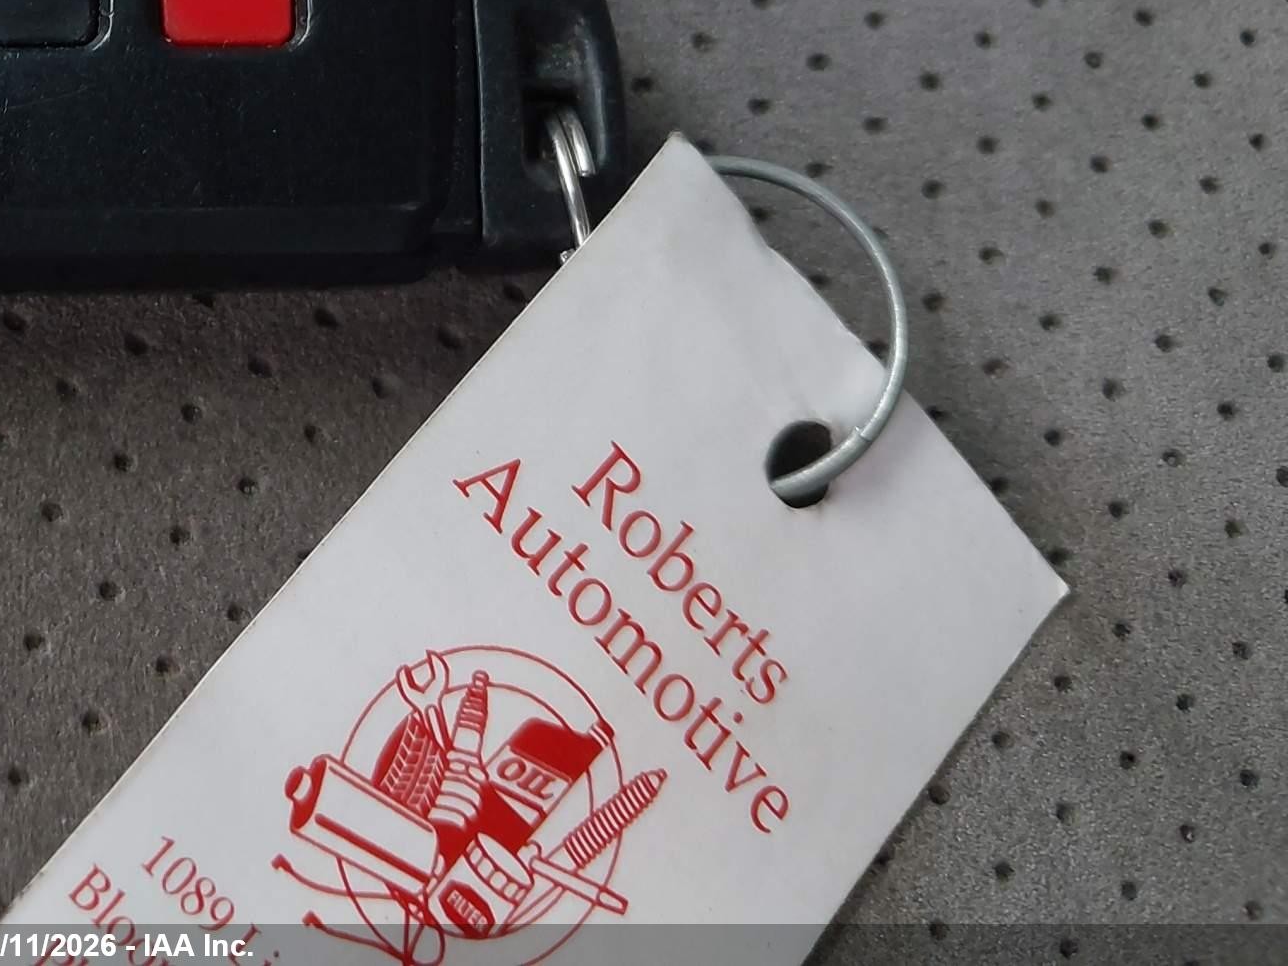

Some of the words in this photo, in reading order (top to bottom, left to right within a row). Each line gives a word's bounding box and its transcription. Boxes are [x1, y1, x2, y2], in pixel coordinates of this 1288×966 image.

[452, 458, 790, 834] Automotive
[571, 440, 789, 705] Roberts
[496, 757, 554, 800] OIL
[141, 835, 235, 932] 1089
